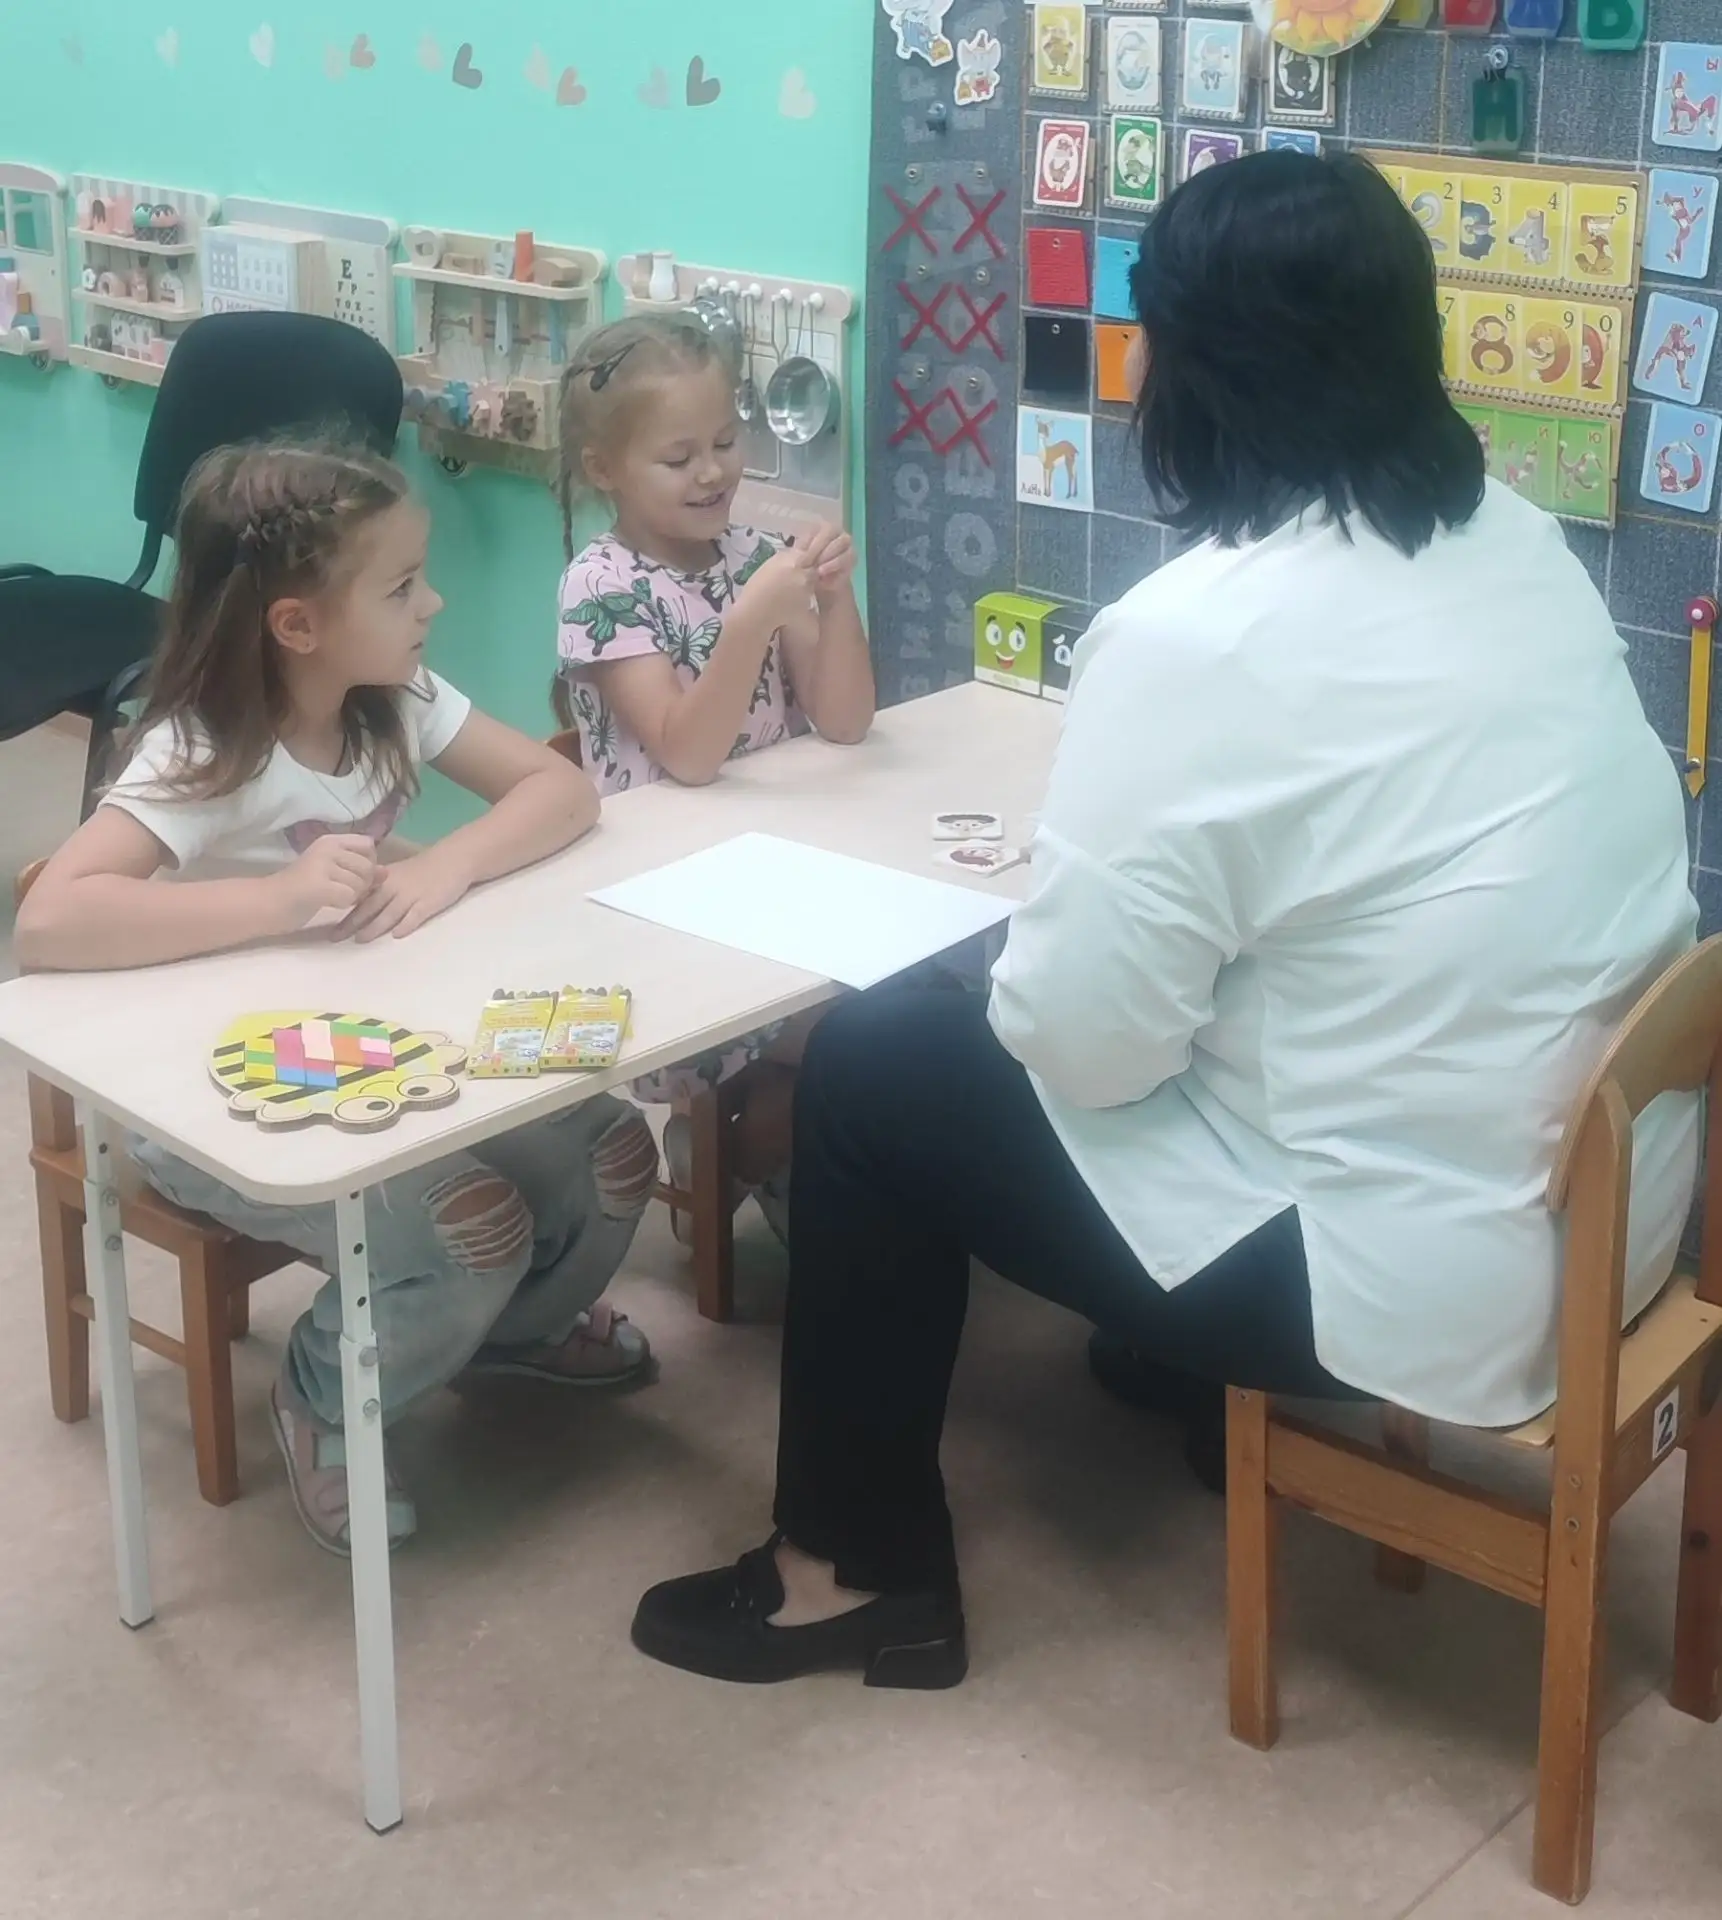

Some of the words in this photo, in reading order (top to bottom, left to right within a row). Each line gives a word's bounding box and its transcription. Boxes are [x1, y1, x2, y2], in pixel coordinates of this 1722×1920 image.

[1706, 57, 1719, 71] Ы
[1472, 78, 1518, 142] Н
[1443, 182, 1454, 200] 2
[1492, 186, 1502, 204] 3
[1548, 192, 1560, 210] 4
[1615, 196, 1627, 215] 5
[341, 259, 352, 279] E
[1445, 297, 1455, 314] 7
[1505, 303, 1515, 321] 8
[1563, 312, 1574, 329] 9
[1588, 431, 1602, 444] Ю
[1657, 1402, 1674, 1452] 2
